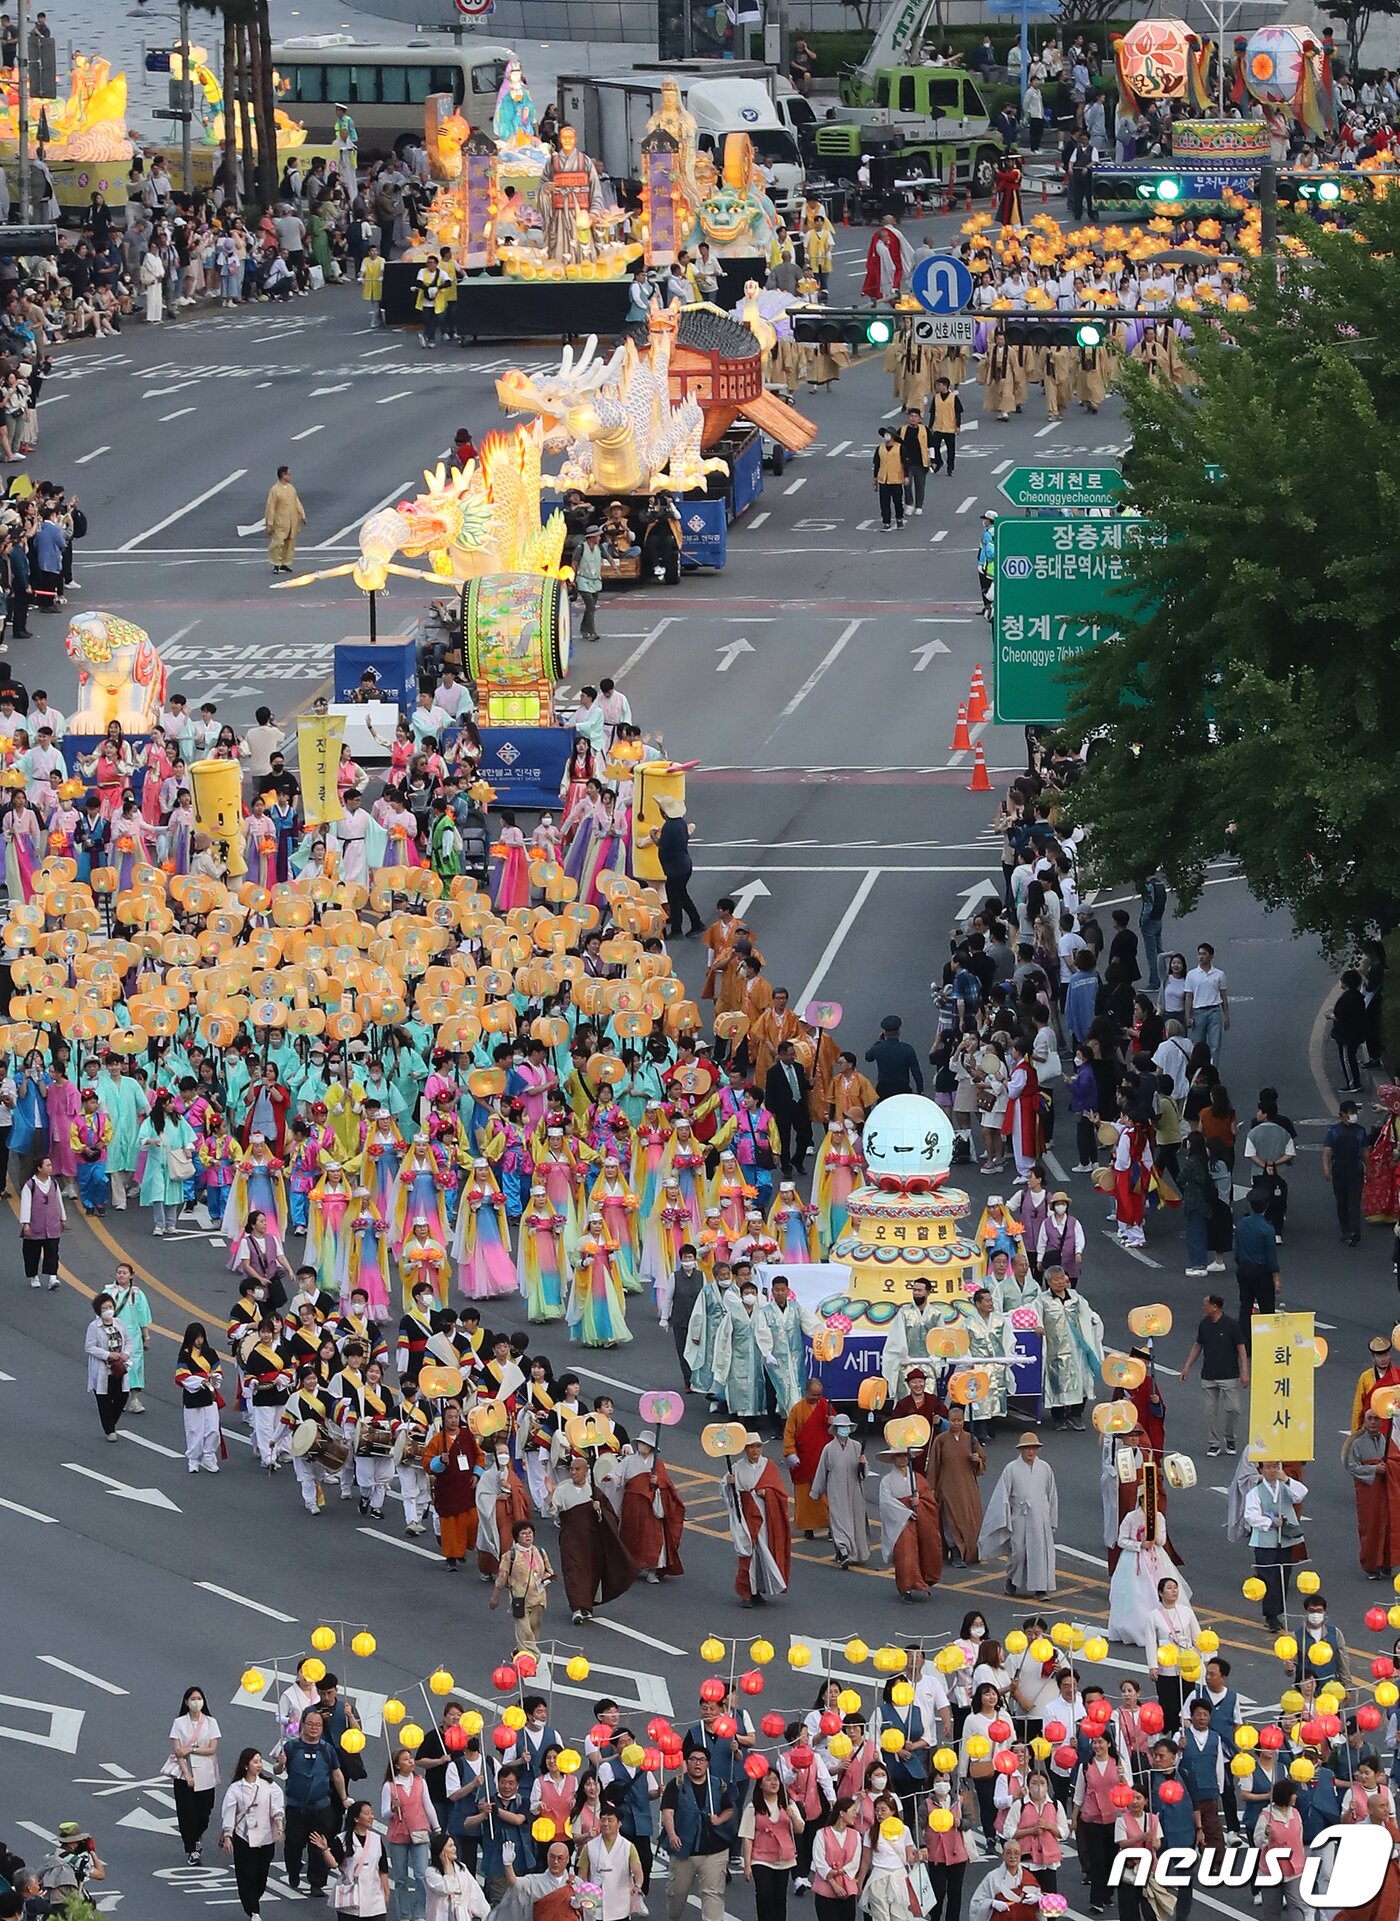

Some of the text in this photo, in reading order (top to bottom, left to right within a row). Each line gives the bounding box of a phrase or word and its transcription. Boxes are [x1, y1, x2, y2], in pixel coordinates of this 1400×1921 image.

[935, 322, 971, 339] 신호시유턴
[1028, 472, 1104, 490] 청계천로
[1009, 560, 1027, 576] 60
[1001, 614, 1101, 641] 청계7가
[1002, 646, 1055, 667] Cheonggye
[315, 738, 327, 802] 진각종
[1273, 1346, 1292, 1429] 화계사
